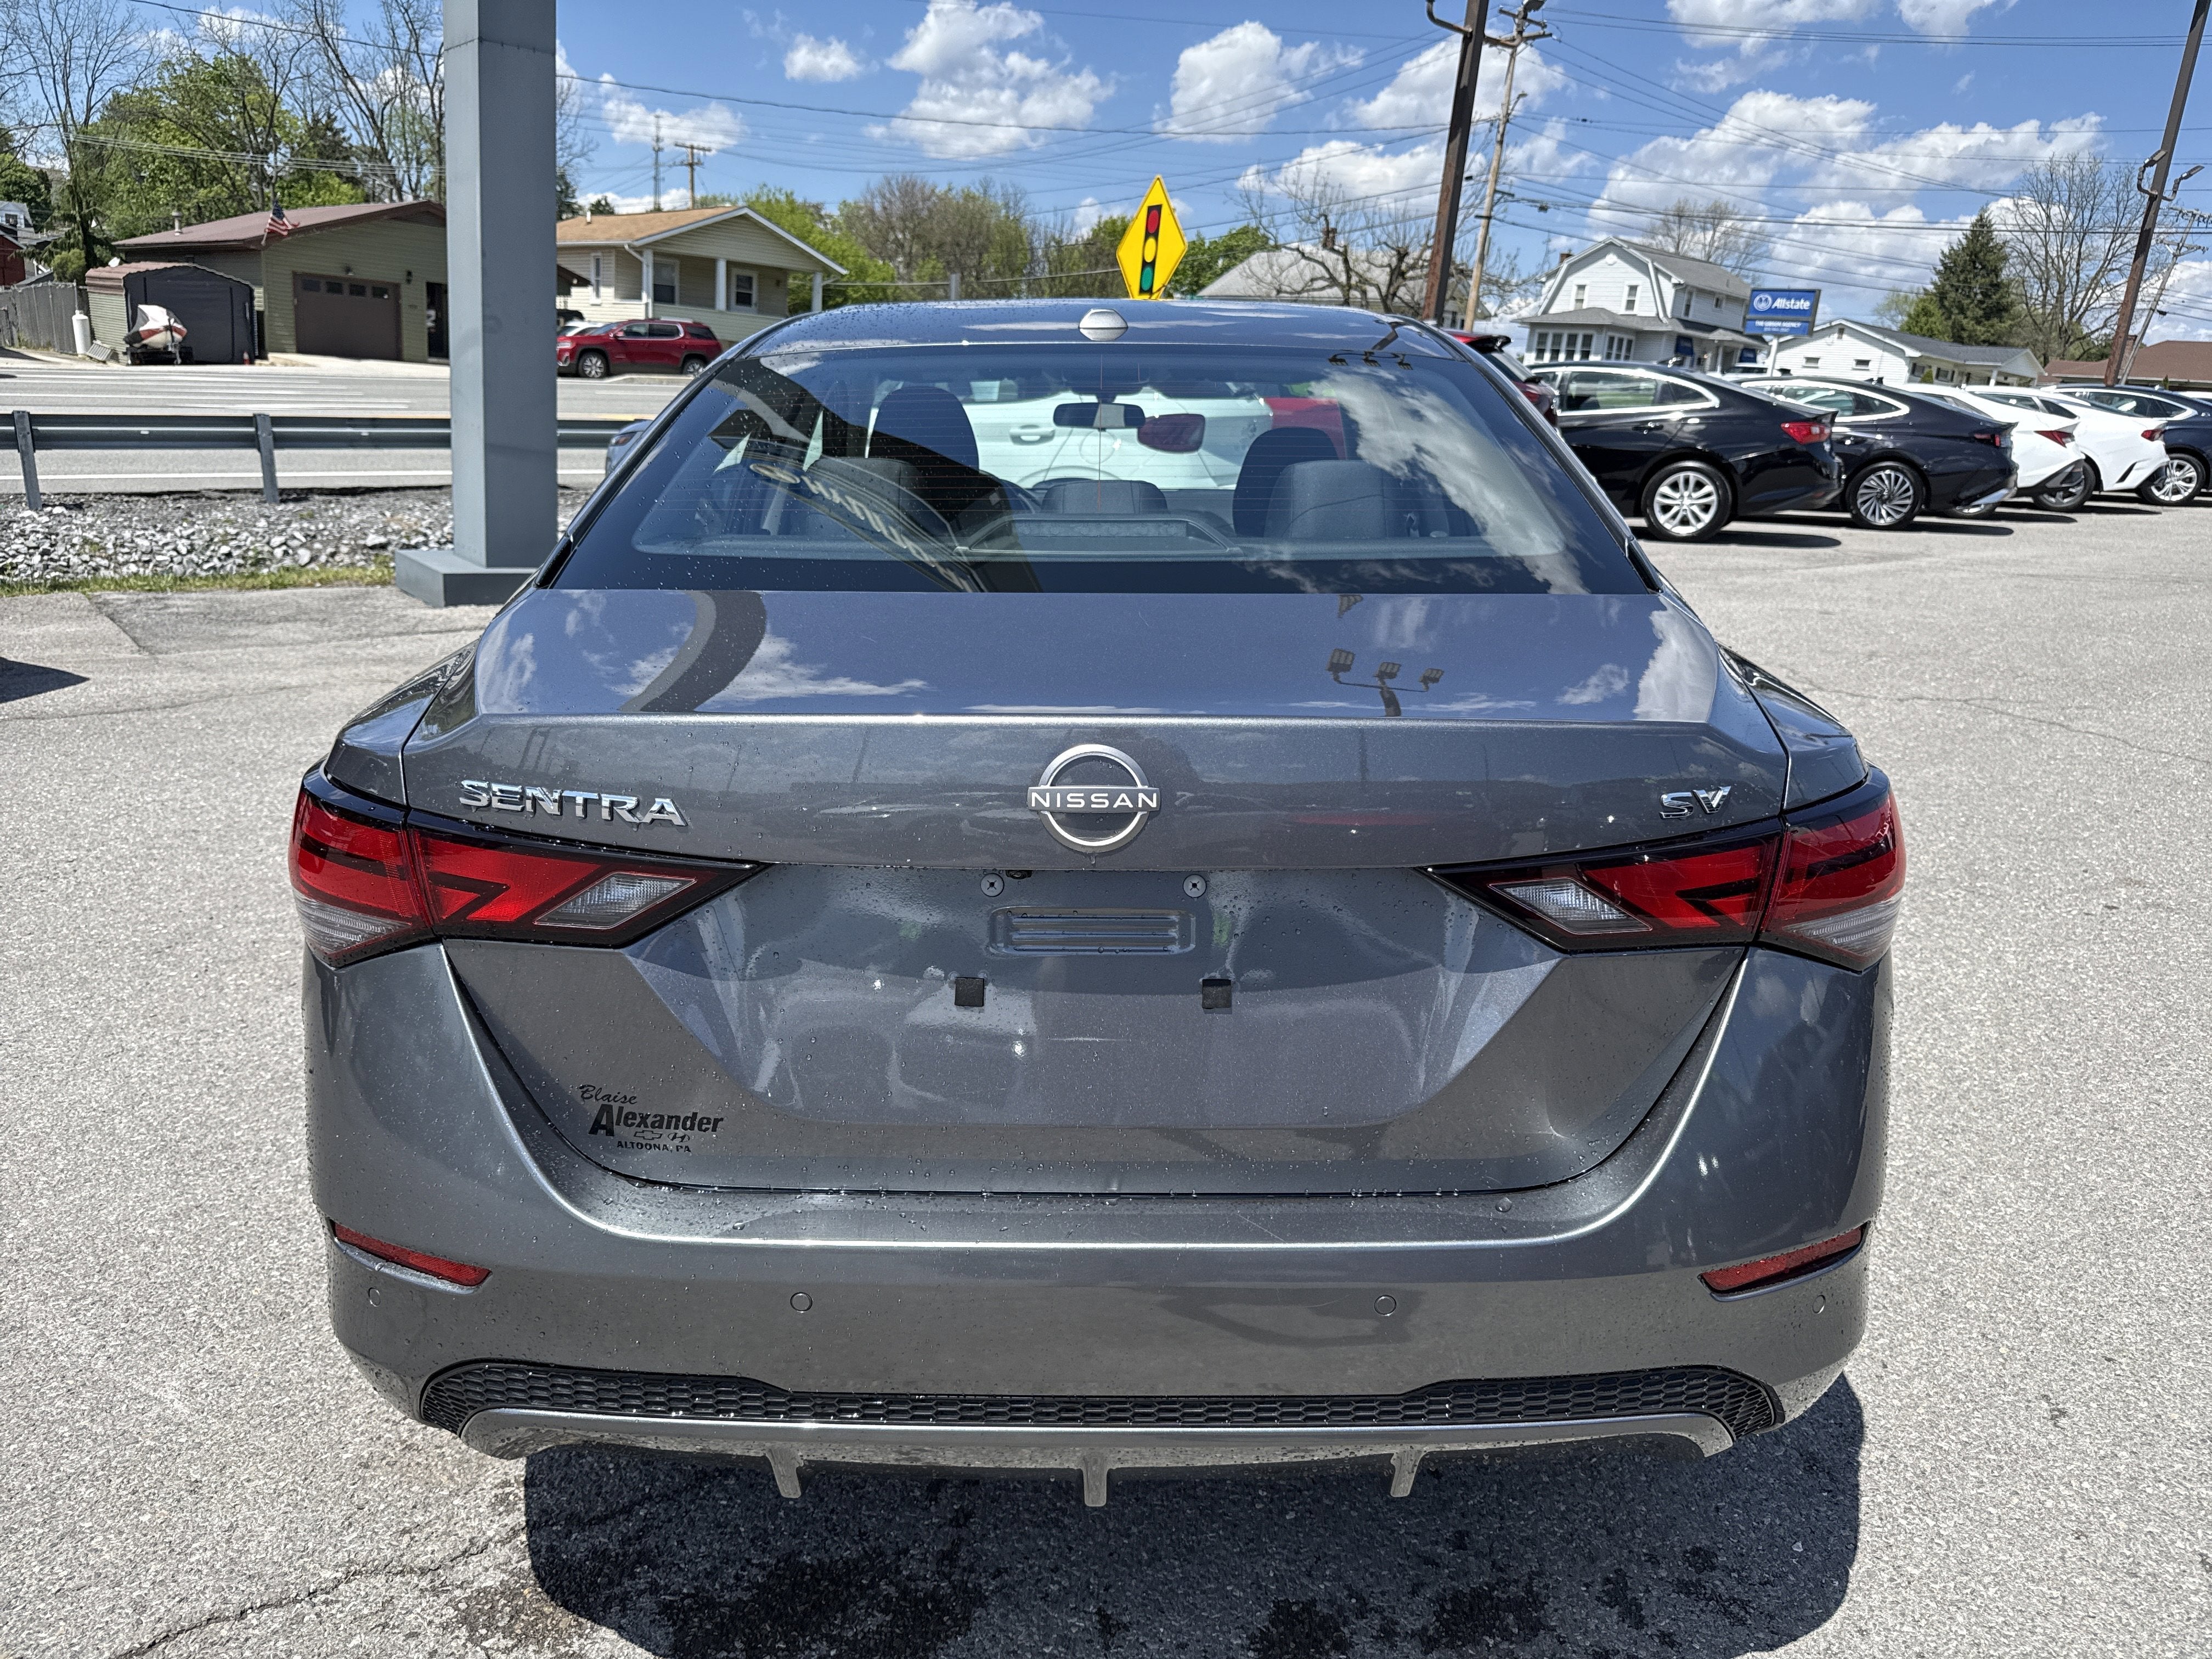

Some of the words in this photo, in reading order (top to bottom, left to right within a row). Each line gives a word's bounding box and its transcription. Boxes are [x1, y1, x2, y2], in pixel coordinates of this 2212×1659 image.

[1771, 297, 1810, 310] Allstate
[459, 780, 689, 826] SENTRA
[1031, 792, 1157, 808] NISSAN
[1659, 785, 1731, 820] SV
[579, 1084, 637, 1104] Blaise
[588, 1103, 724, 1137] Alexander
[617, 1140, 673, 1153] ALTOONA,
